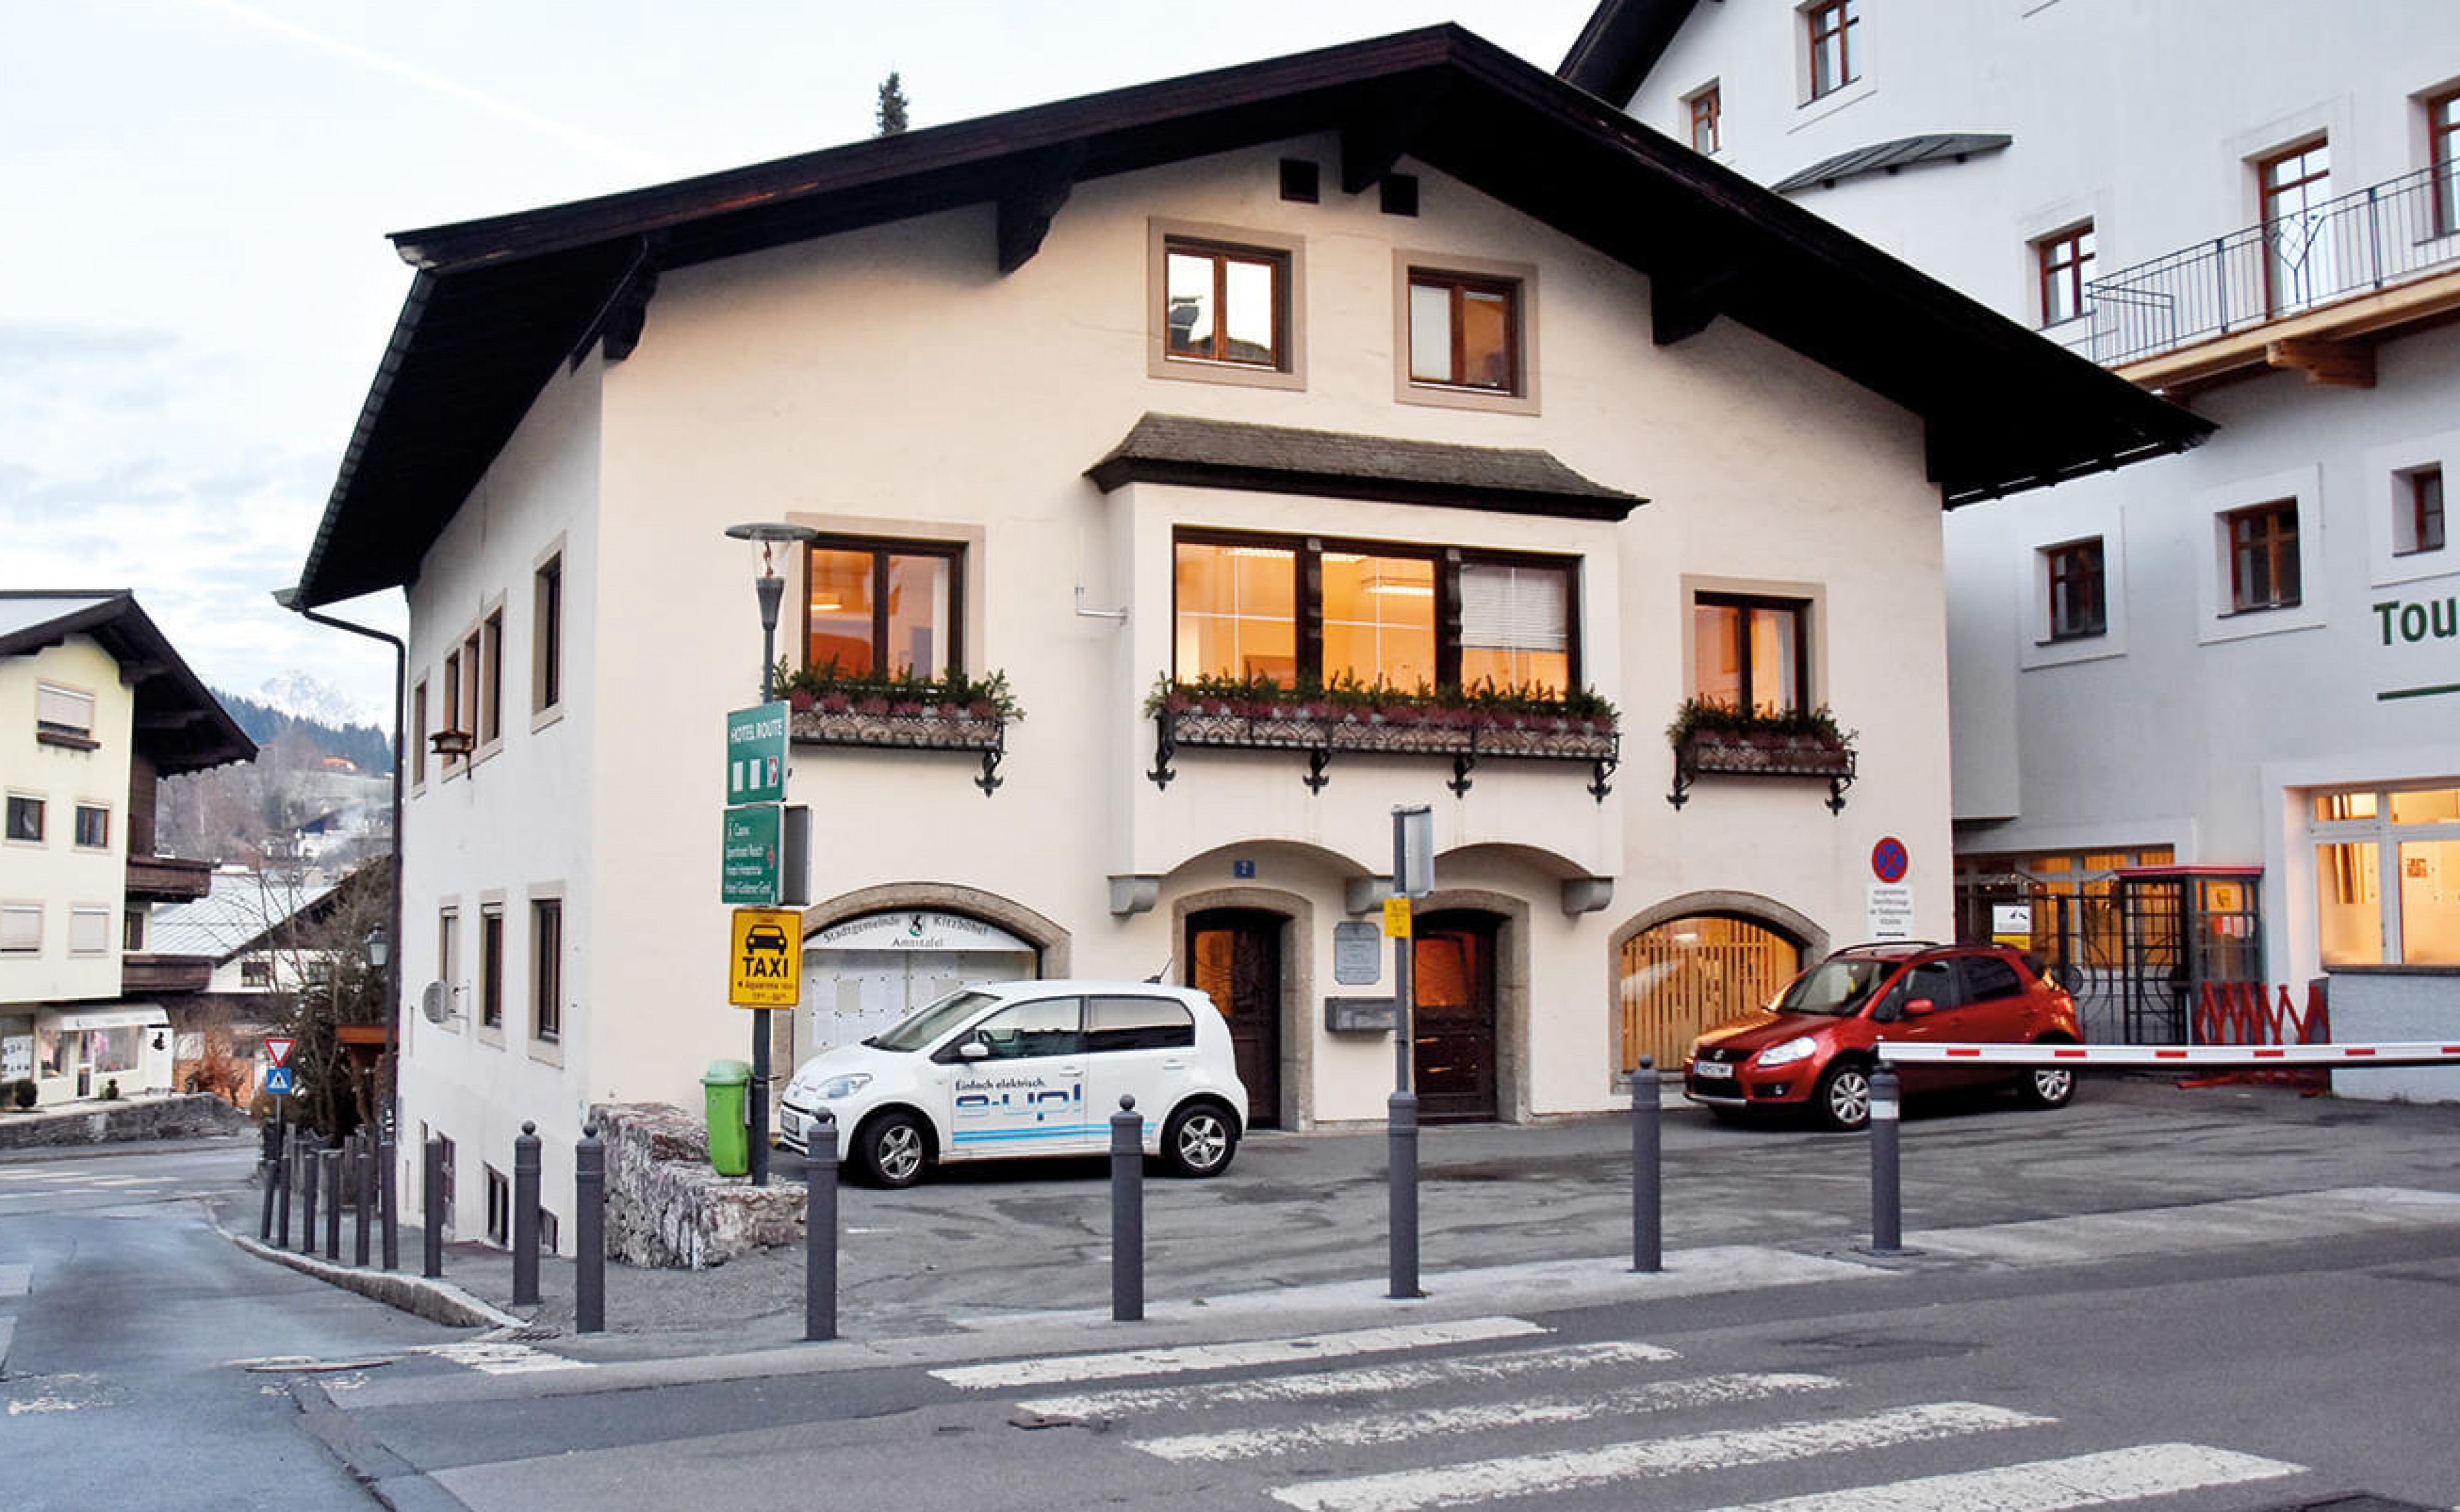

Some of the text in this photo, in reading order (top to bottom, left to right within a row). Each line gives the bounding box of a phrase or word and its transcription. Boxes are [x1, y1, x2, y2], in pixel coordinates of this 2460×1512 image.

[2372, 596, 2457, 646] TOU
[730, 719, 783, 743] HOTEL ROUTE
[823, 916, 900, 942] Stadtgemeinde
[742, 956, 789, 977] TAXI
[955, 1079, 994, 1091] Einfach
